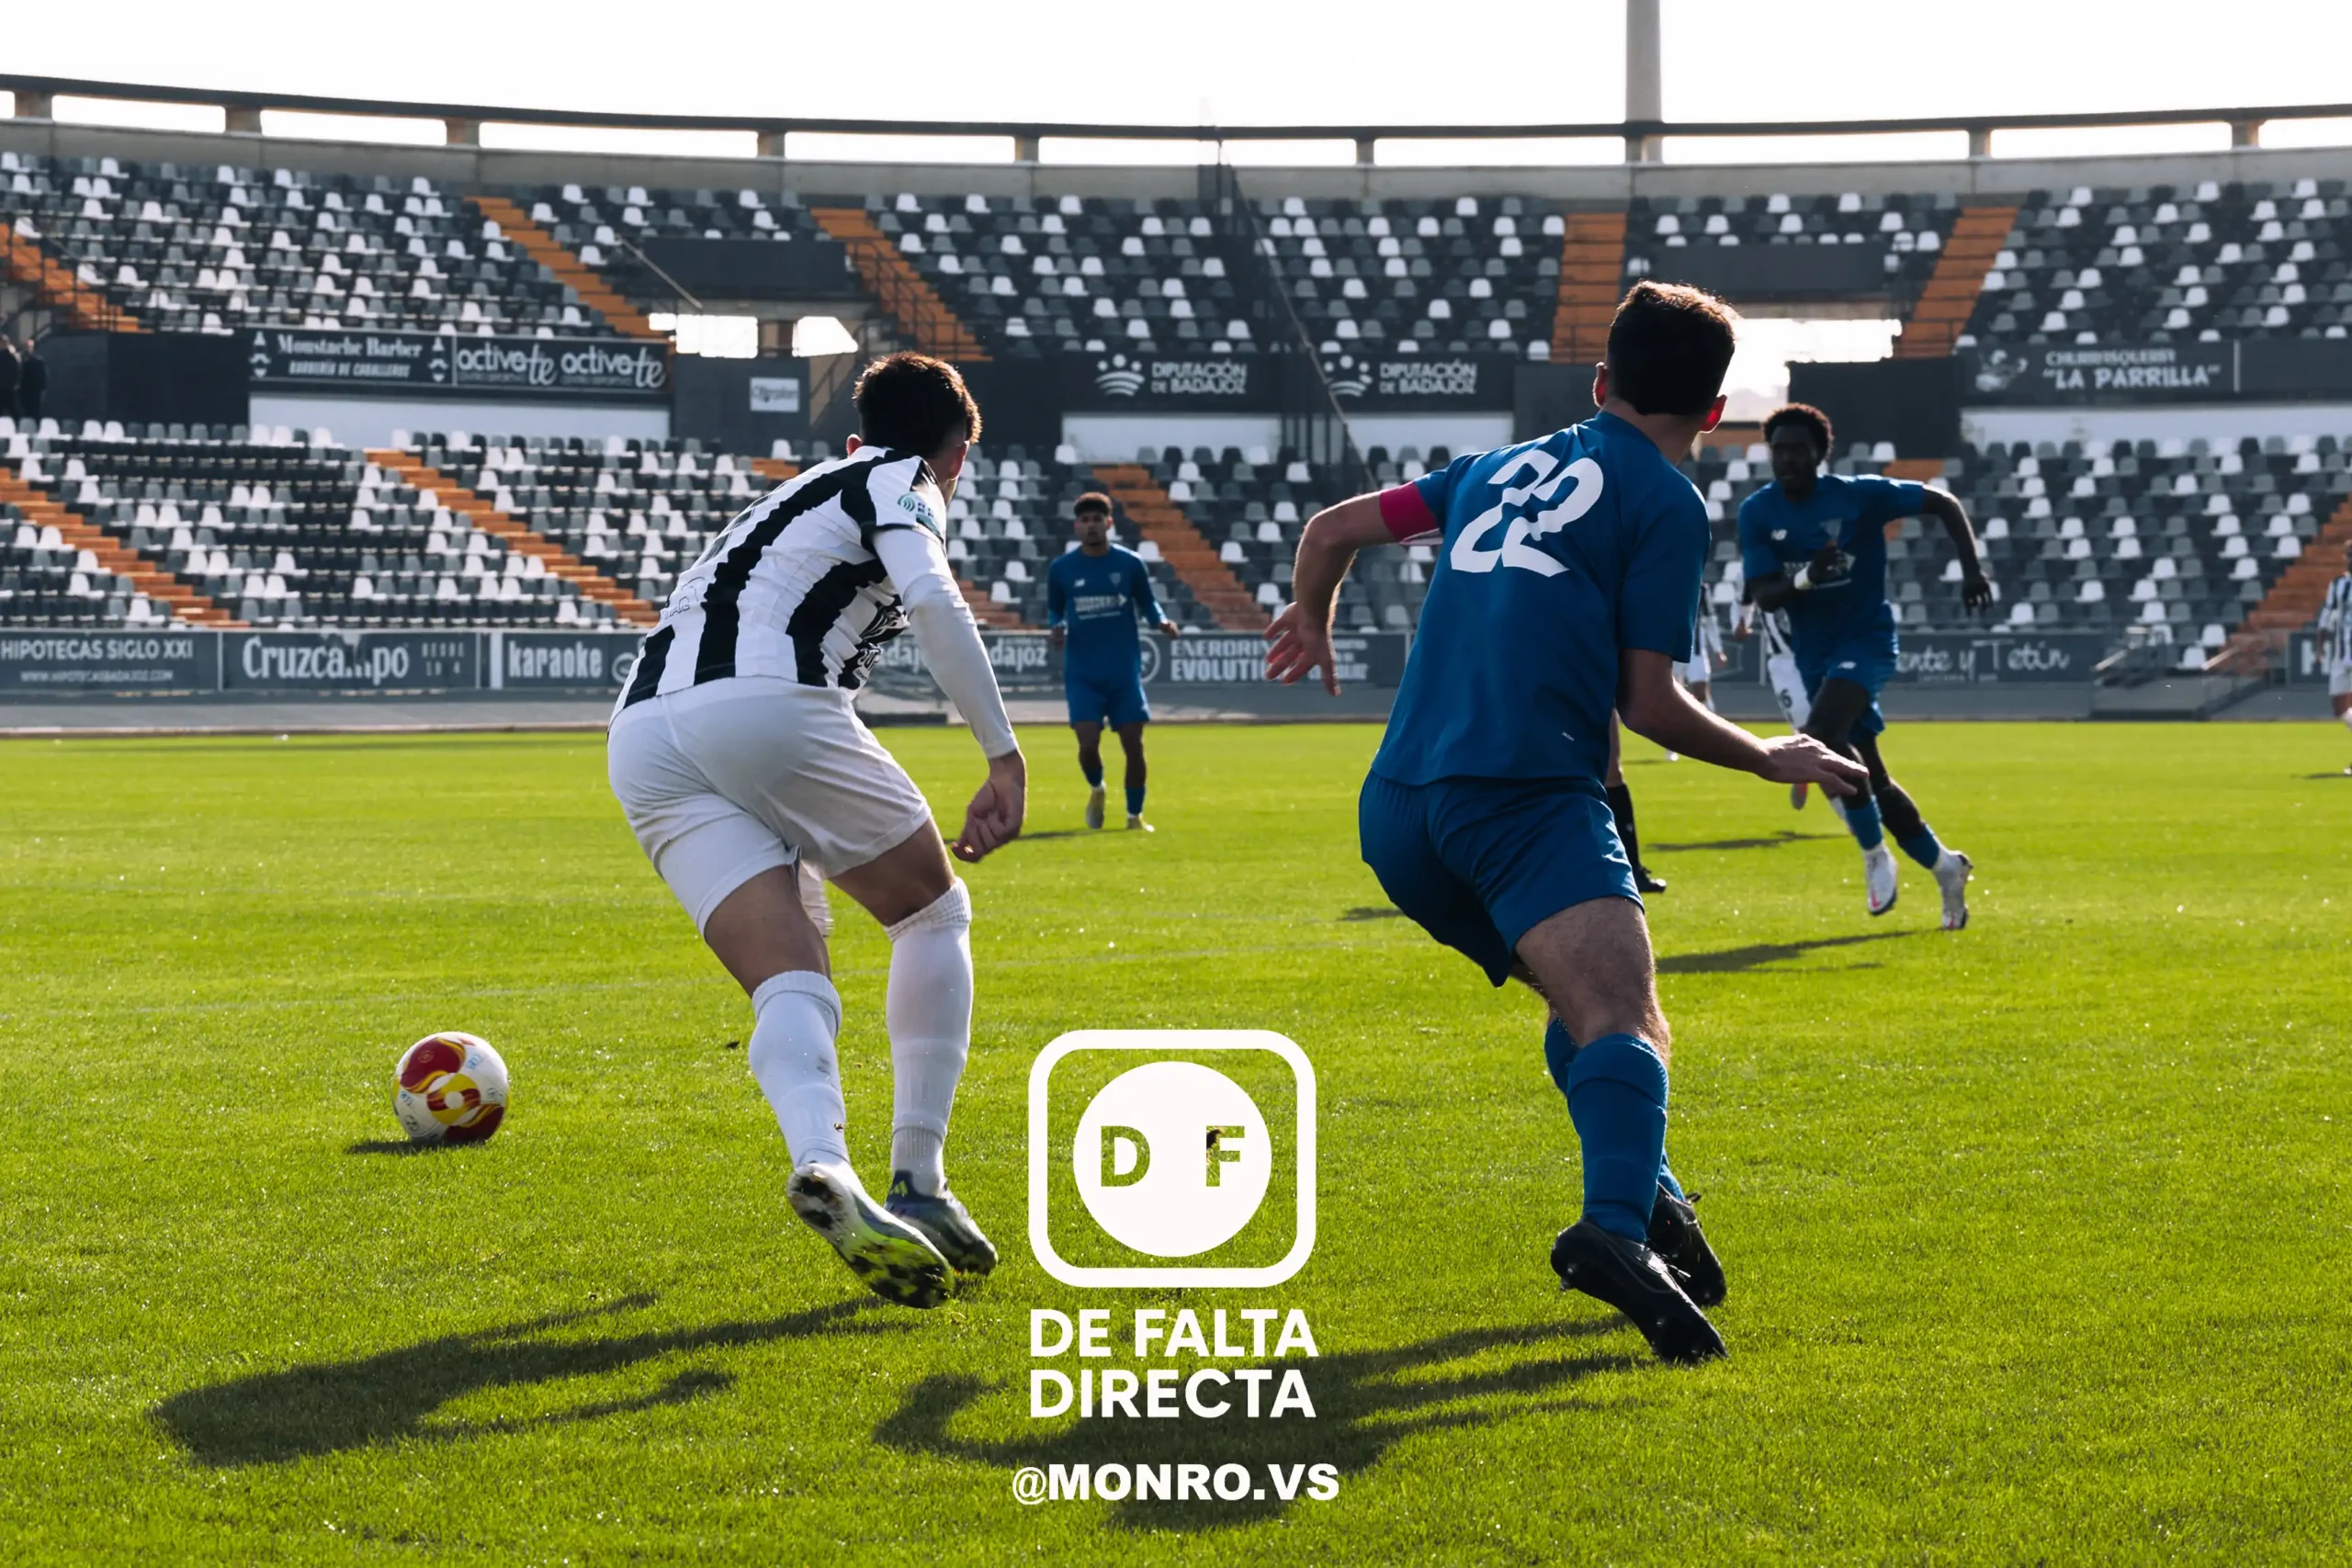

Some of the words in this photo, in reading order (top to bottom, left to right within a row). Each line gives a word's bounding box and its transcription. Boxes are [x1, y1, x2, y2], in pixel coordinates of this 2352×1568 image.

[277, 333, 363, 355] Moustache
[367, 336, 423, 357] Barber
[1170, 378, 1247, 394] BADAJOZ
[1399, 378, 1476, 394] BADAJOZ
[1450, 449, 1604, 578] 22
[1, 638, 104, 660] HIPOTECAS
[107, 639, 161, 660] SIGLO
[163, 639, 194, 660] XXI
[508, 640, 603, 678] karaoke
[989, 637, 1047, 672] dajoz
[1170, 659, 1267, 681] EVOLUTI
